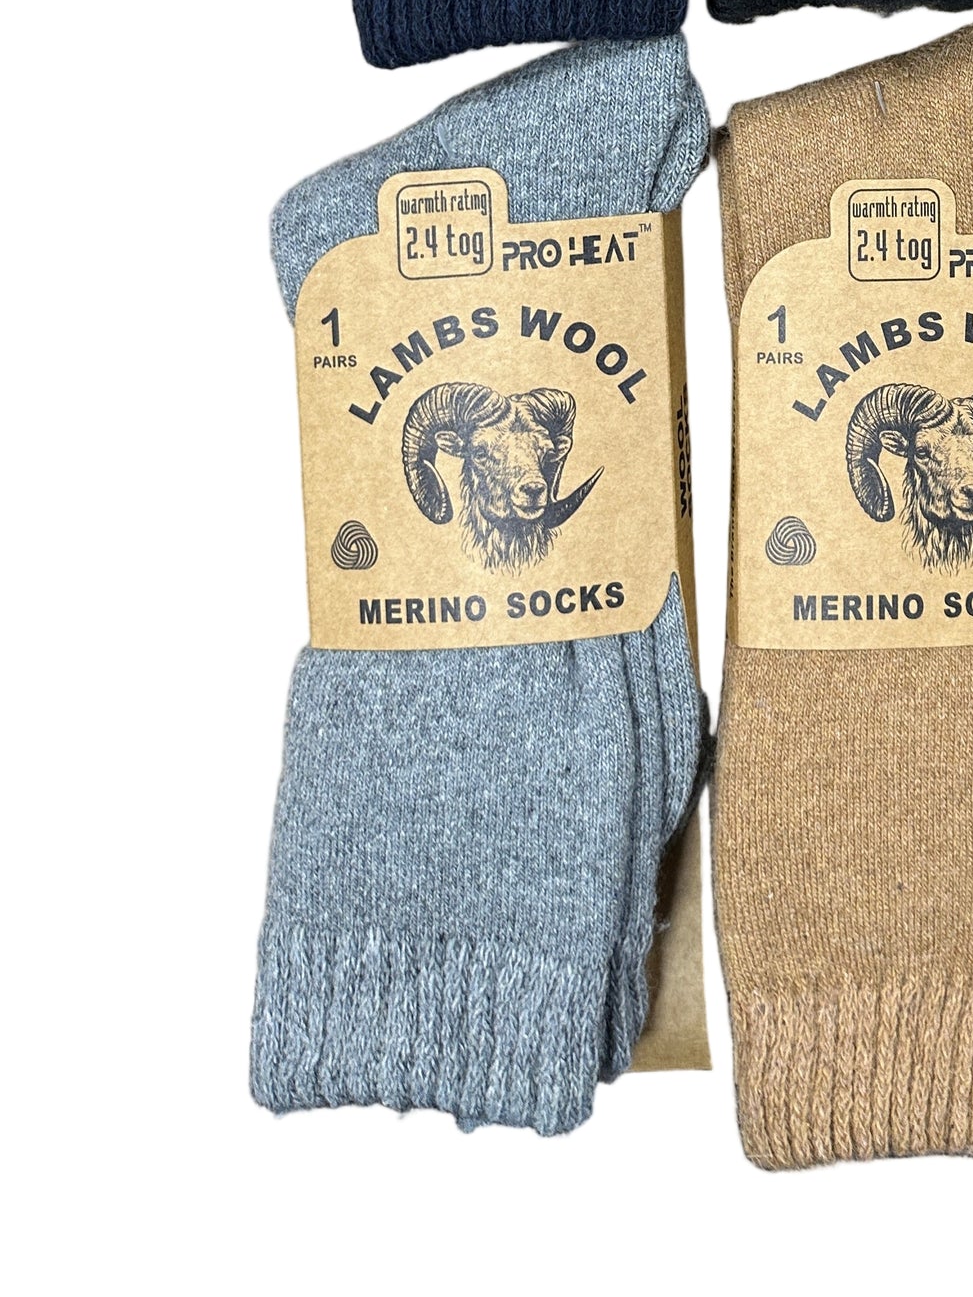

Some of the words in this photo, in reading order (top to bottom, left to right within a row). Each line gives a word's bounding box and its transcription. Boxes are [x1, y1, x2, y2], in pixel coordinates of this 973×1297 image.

[400, 190, 447, 215] warmth
[450, 188, 487, 216] rating
[852, 195, 898, 218] warmth
[901, 195, 936, 223] rating
[406, 225, 438, 260] 2.4
[446, 224, 484, 264] tog
[857, 229, 888, 262] 2.4
[895, 229, 932, 270] tog
[320, 307, 340, 347] 1
[767, 305, 787, 344] 1
[313, 354, 357, 369] PAIRS
[348, 306, 499, 425] LAMBS
[520, 305, 648, 405] WOOL
[757, 352, 803, 364] PAIRS
[792, 311, 945, 423] LAMBS
[677, 395, 688, 518] WOOL
[359, 595, 487, 625] MERINO
[507, 581, 625, 619] SOCKS
[793, 593, 924, 621] MERINO
